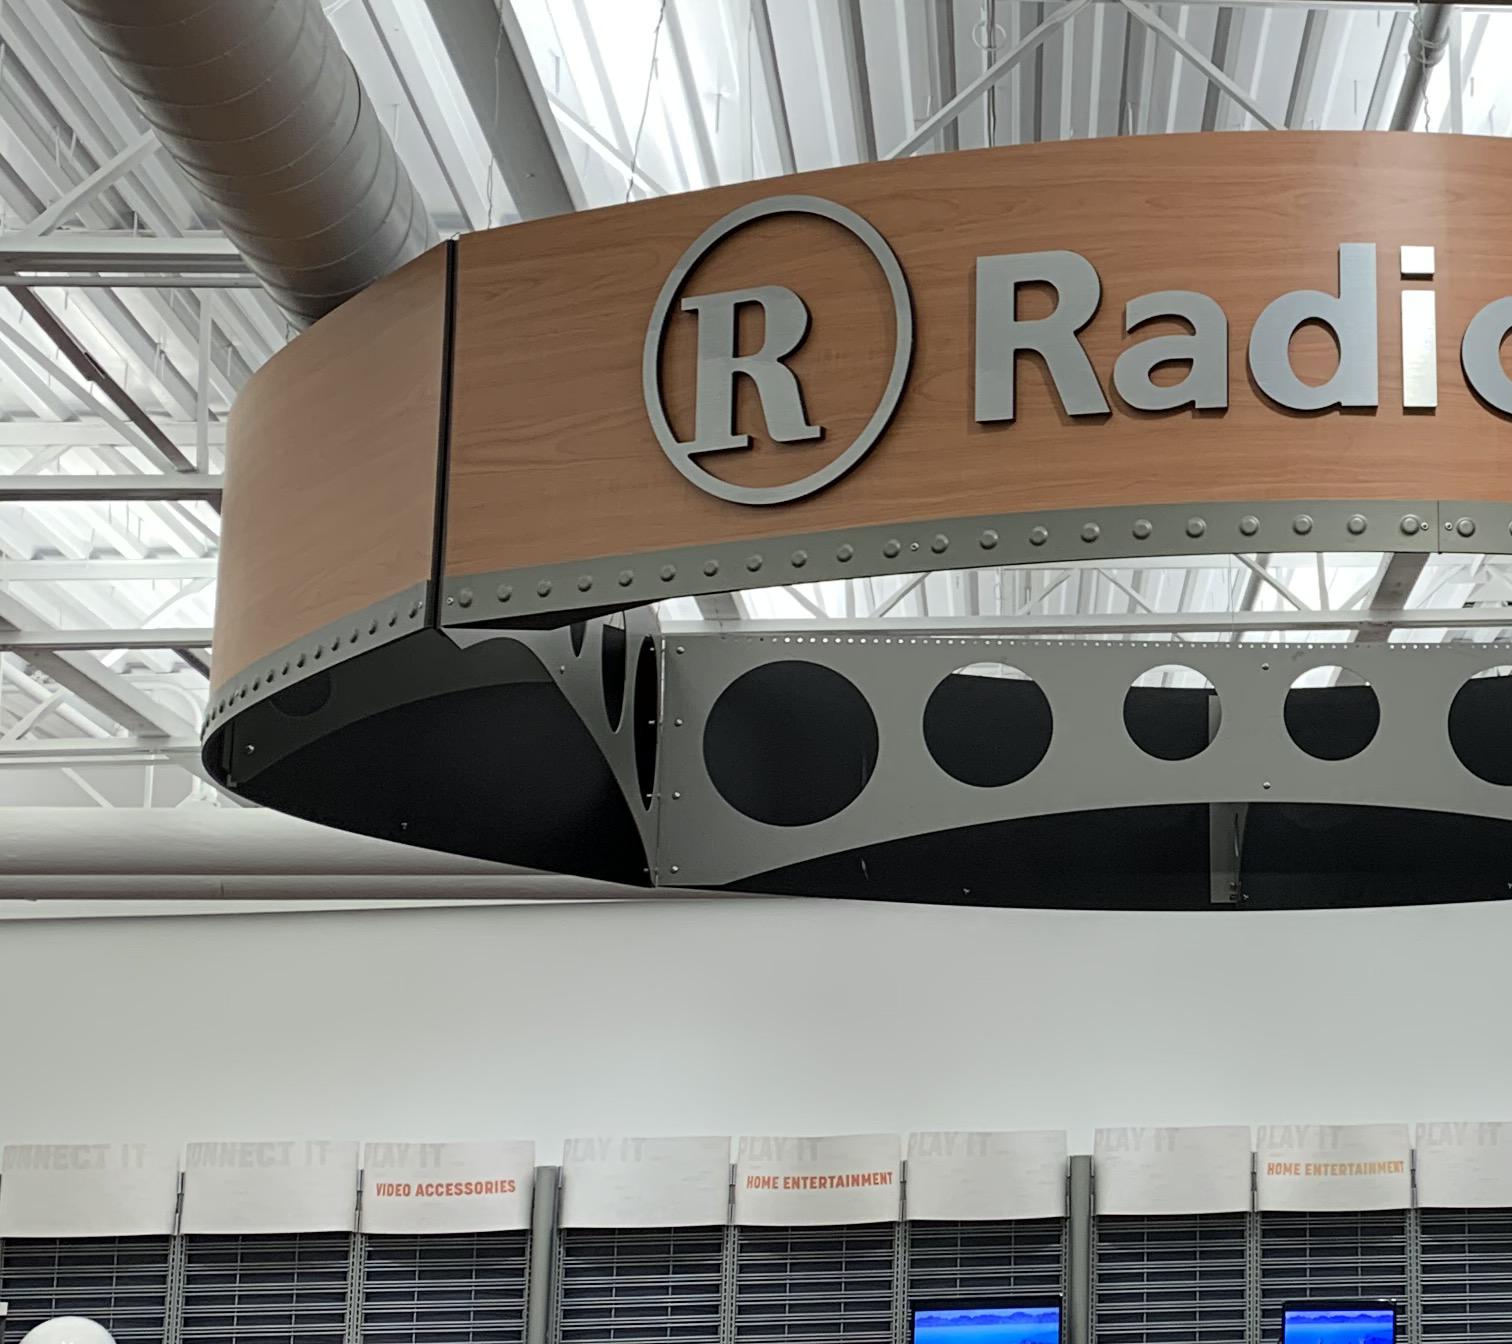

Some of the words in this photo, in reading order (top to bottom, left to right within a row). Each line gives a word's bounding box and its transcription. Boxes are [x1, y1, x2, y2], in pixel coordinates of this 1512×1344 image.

[1266, 1162, 1301, 1176] HOME
[1304, 1160, 1405, 1176] ENTERTAINMENT
[376, 1182, 411, 1197] VIDEO
[415, 1179, 516, 1197] ACCESSORIES
[746, 1174, 779, 1189] HOME
[783, 1171, 893, 1189] ENTERTAINMENT
